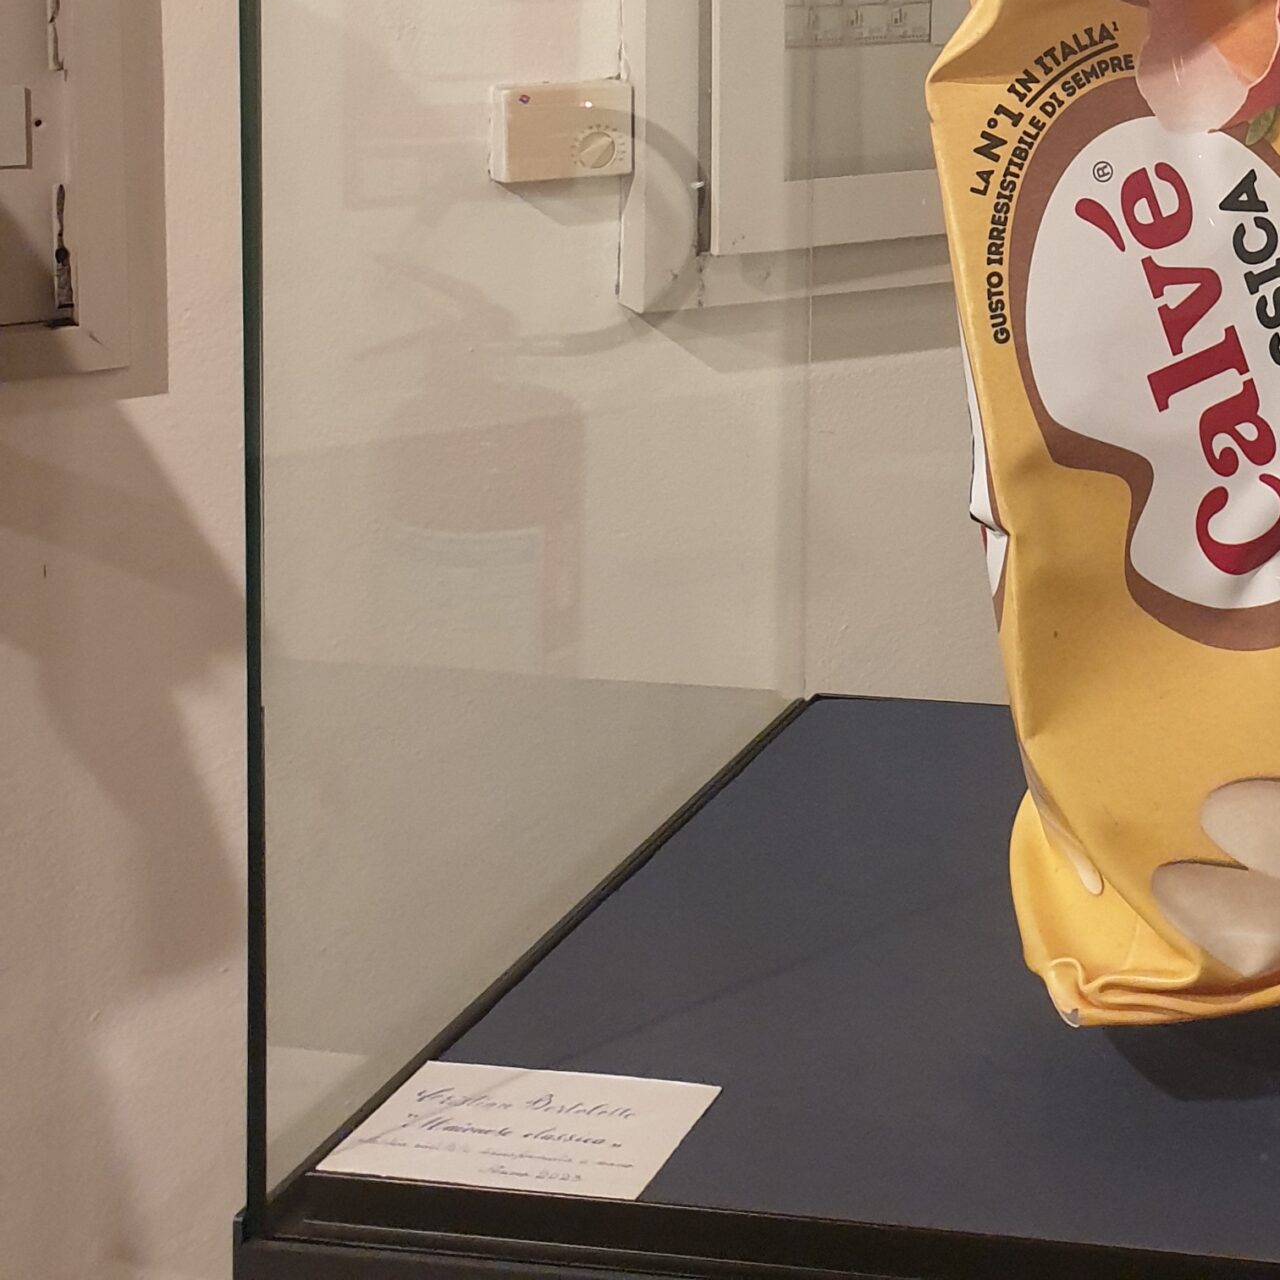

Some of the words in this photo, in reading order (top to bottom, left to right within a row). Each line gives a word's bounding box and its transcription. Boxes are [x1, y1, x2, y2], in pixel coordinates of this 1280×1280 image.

[1039, 91, 1065, 119] DI
[1065, 54, 1135, 97] SEMPRE
[970, 169, 995, 196] LA
[1007, 69, 1040, 102] IN
[987, 115, 1046, 266] IRRESISTIBILE
[987, 271, 1010, 344] GUSTO
